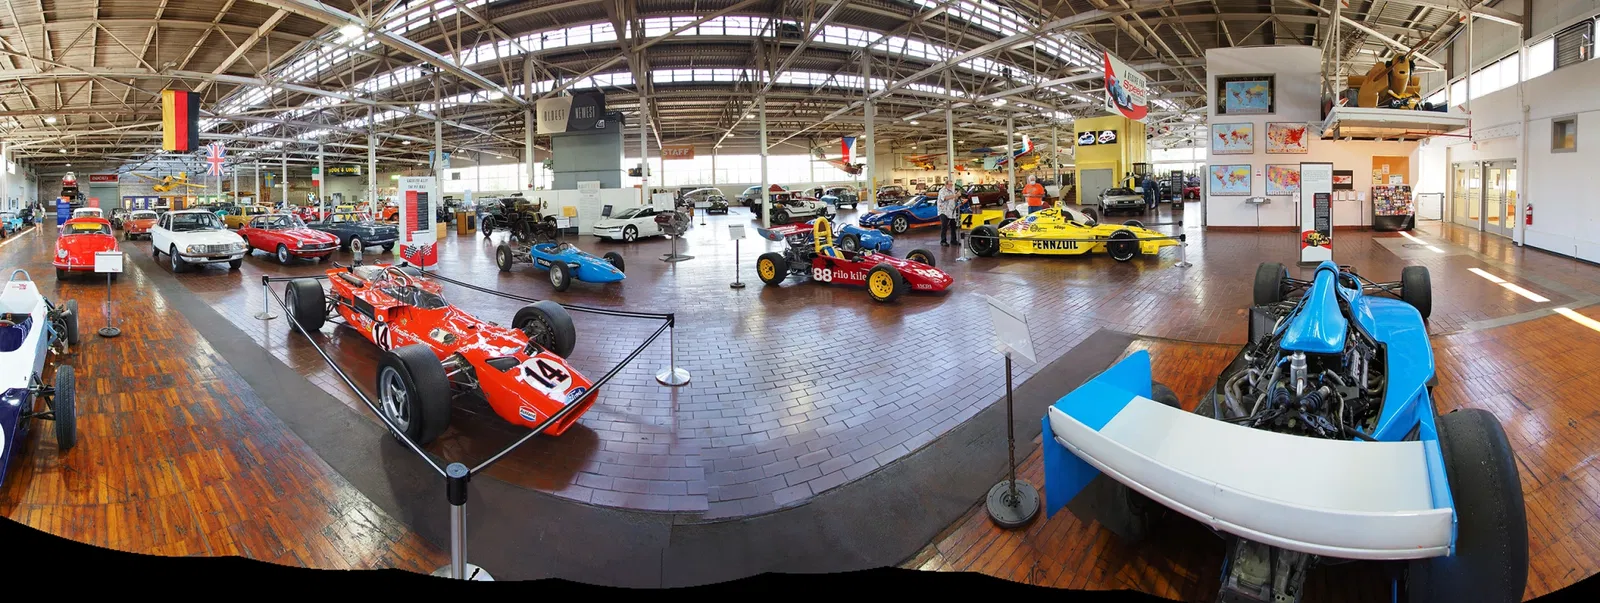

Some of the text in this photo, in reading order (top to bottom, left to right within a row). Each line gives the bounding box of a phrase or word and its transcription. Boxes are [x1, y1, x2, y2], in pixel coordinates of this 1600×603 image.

[544, 109, 565, 122] OLDEST
[575, 106, 595, 119] NEWEST
[663, 148, 690, 156] STAFF
[962, 214, 973, 228] 4
[1032, 239, 1079, 250] PENNZOIL
[813, 267, 833, 283] 88
[833, 270, 849, 280] rilo
[374, 321, 390, 352] 14
[524, 359, 571, 389] 14
[568, 388, 583, 401] Ford
[520, 409, 536, 419] Ashland
